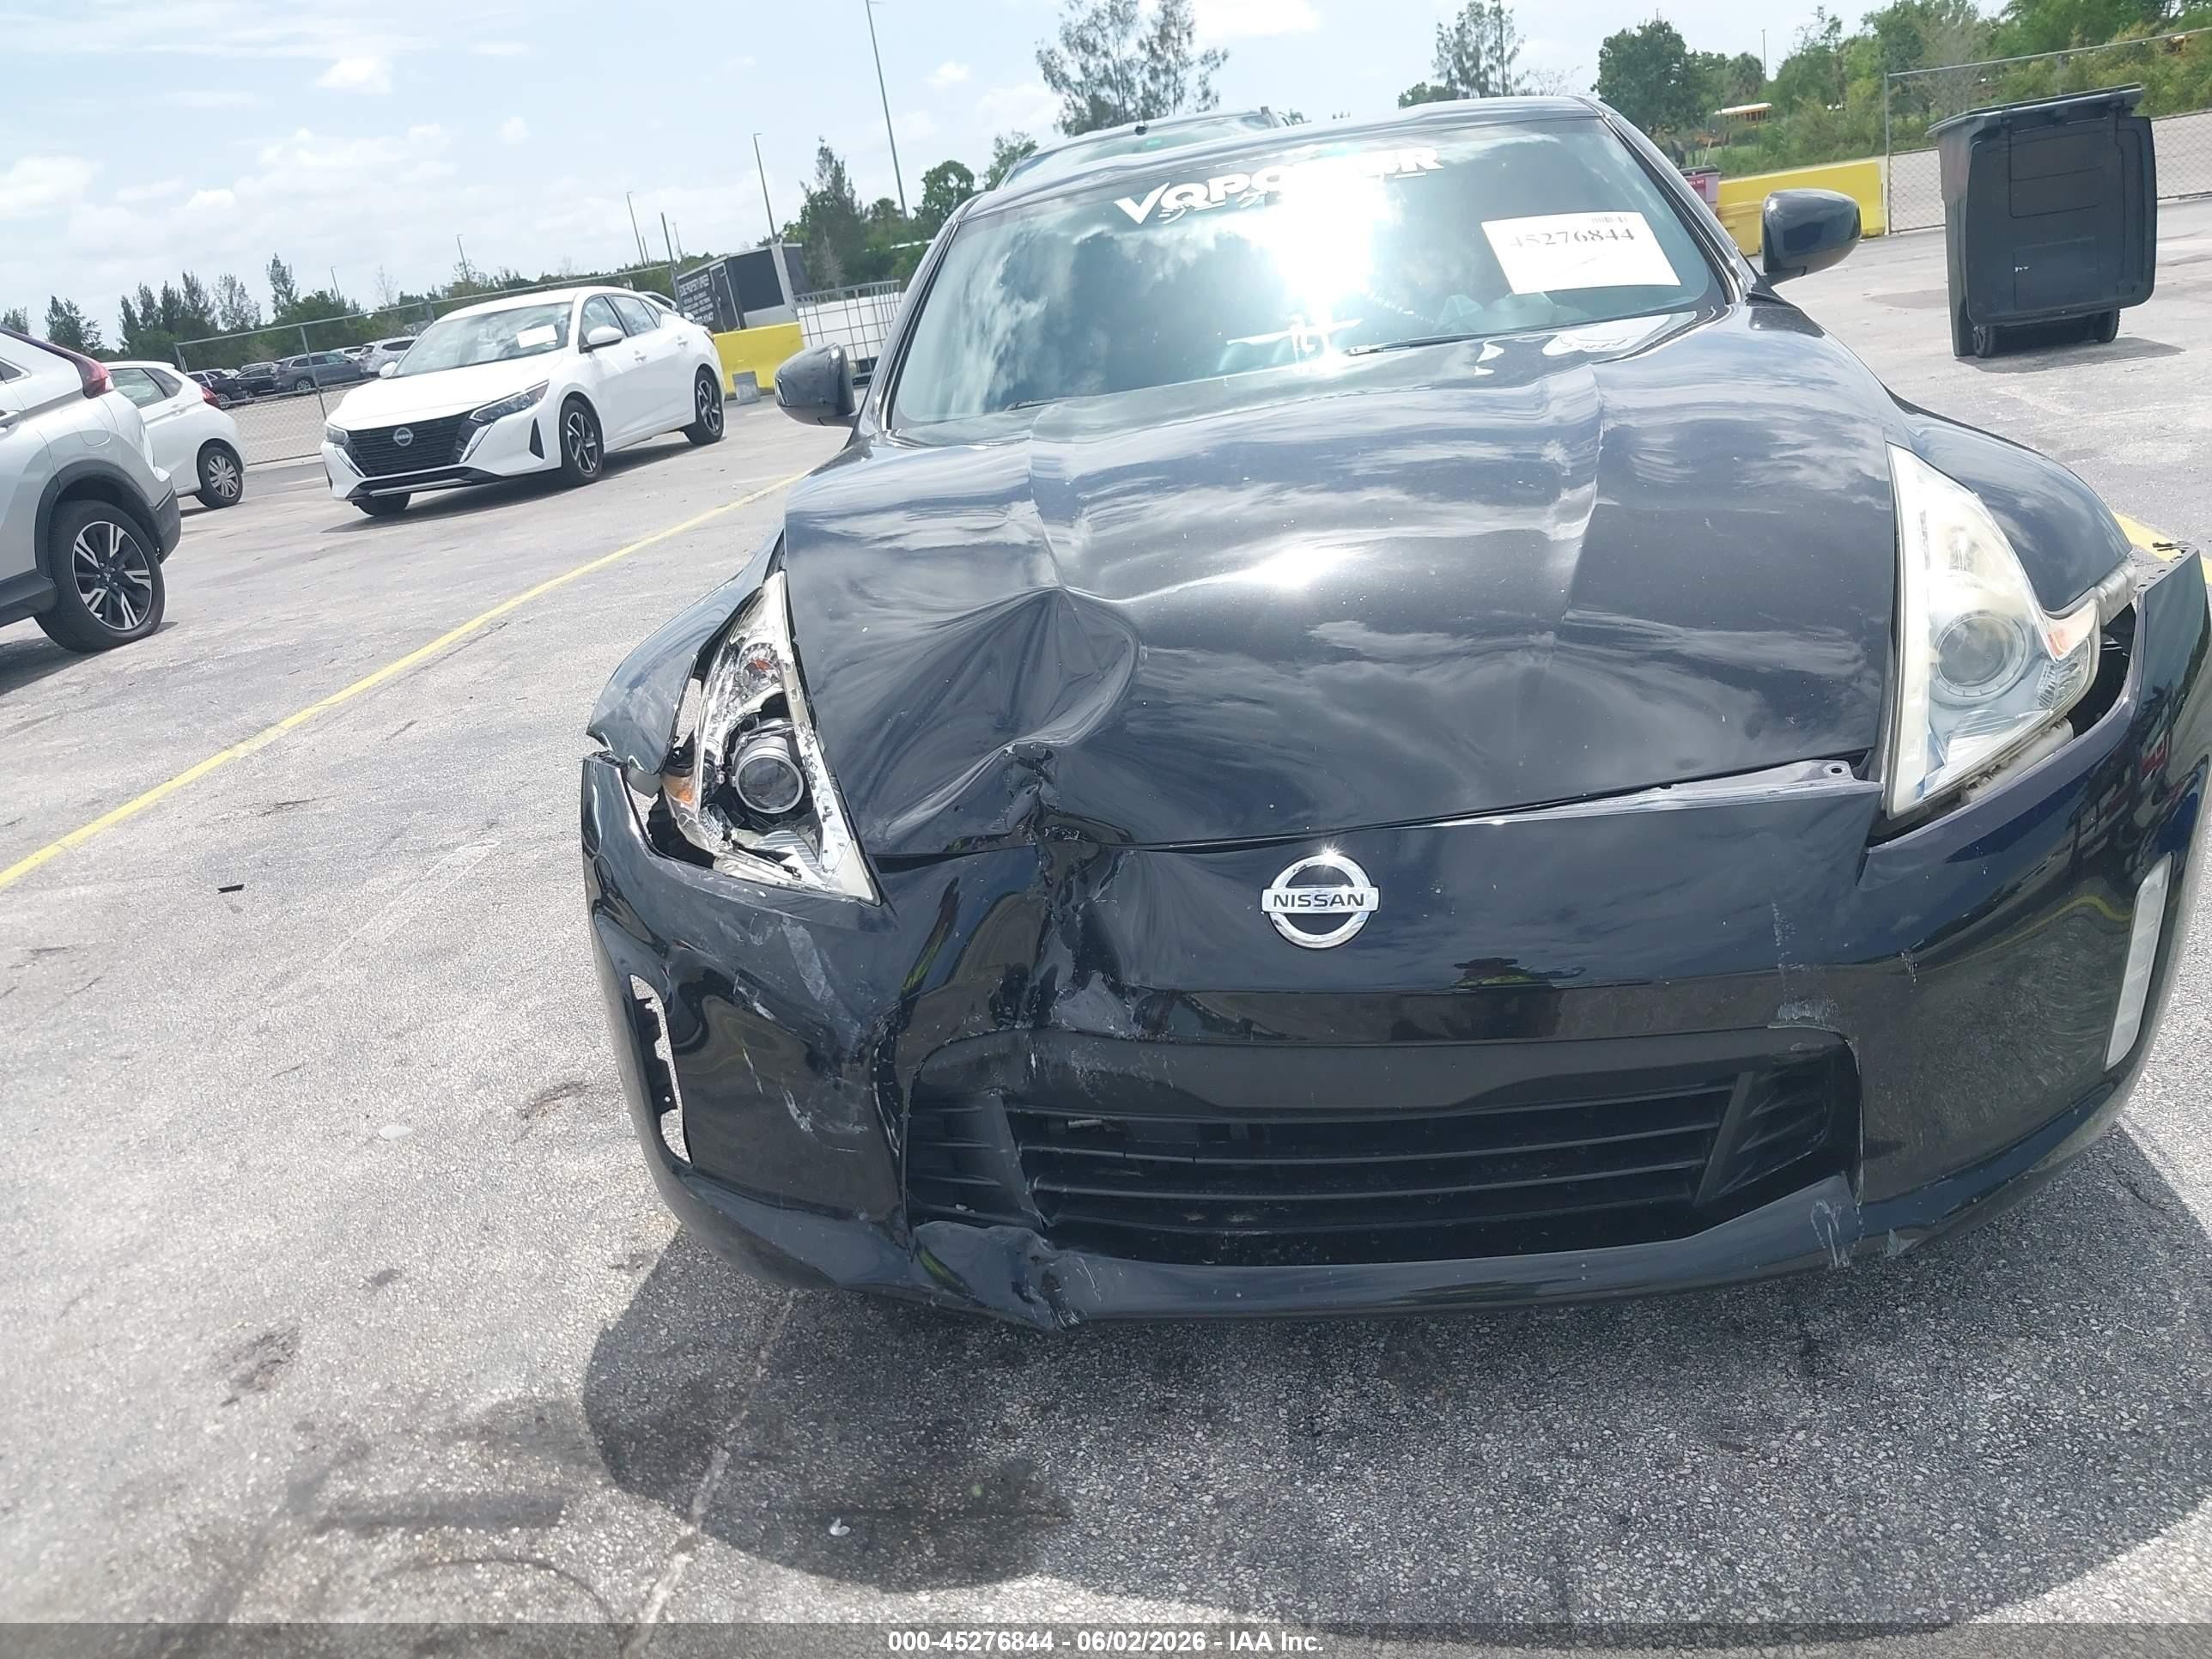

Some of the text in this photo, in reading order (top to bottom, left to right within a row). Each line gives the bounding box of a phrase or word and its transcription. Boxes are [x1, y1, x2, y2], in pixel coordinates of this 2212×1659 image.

[1114, 147, 1443, 224] VQPOR
[1510, 228, 1636, 248] 45276844
[1273, 893, 1364, 908] NISSAN
